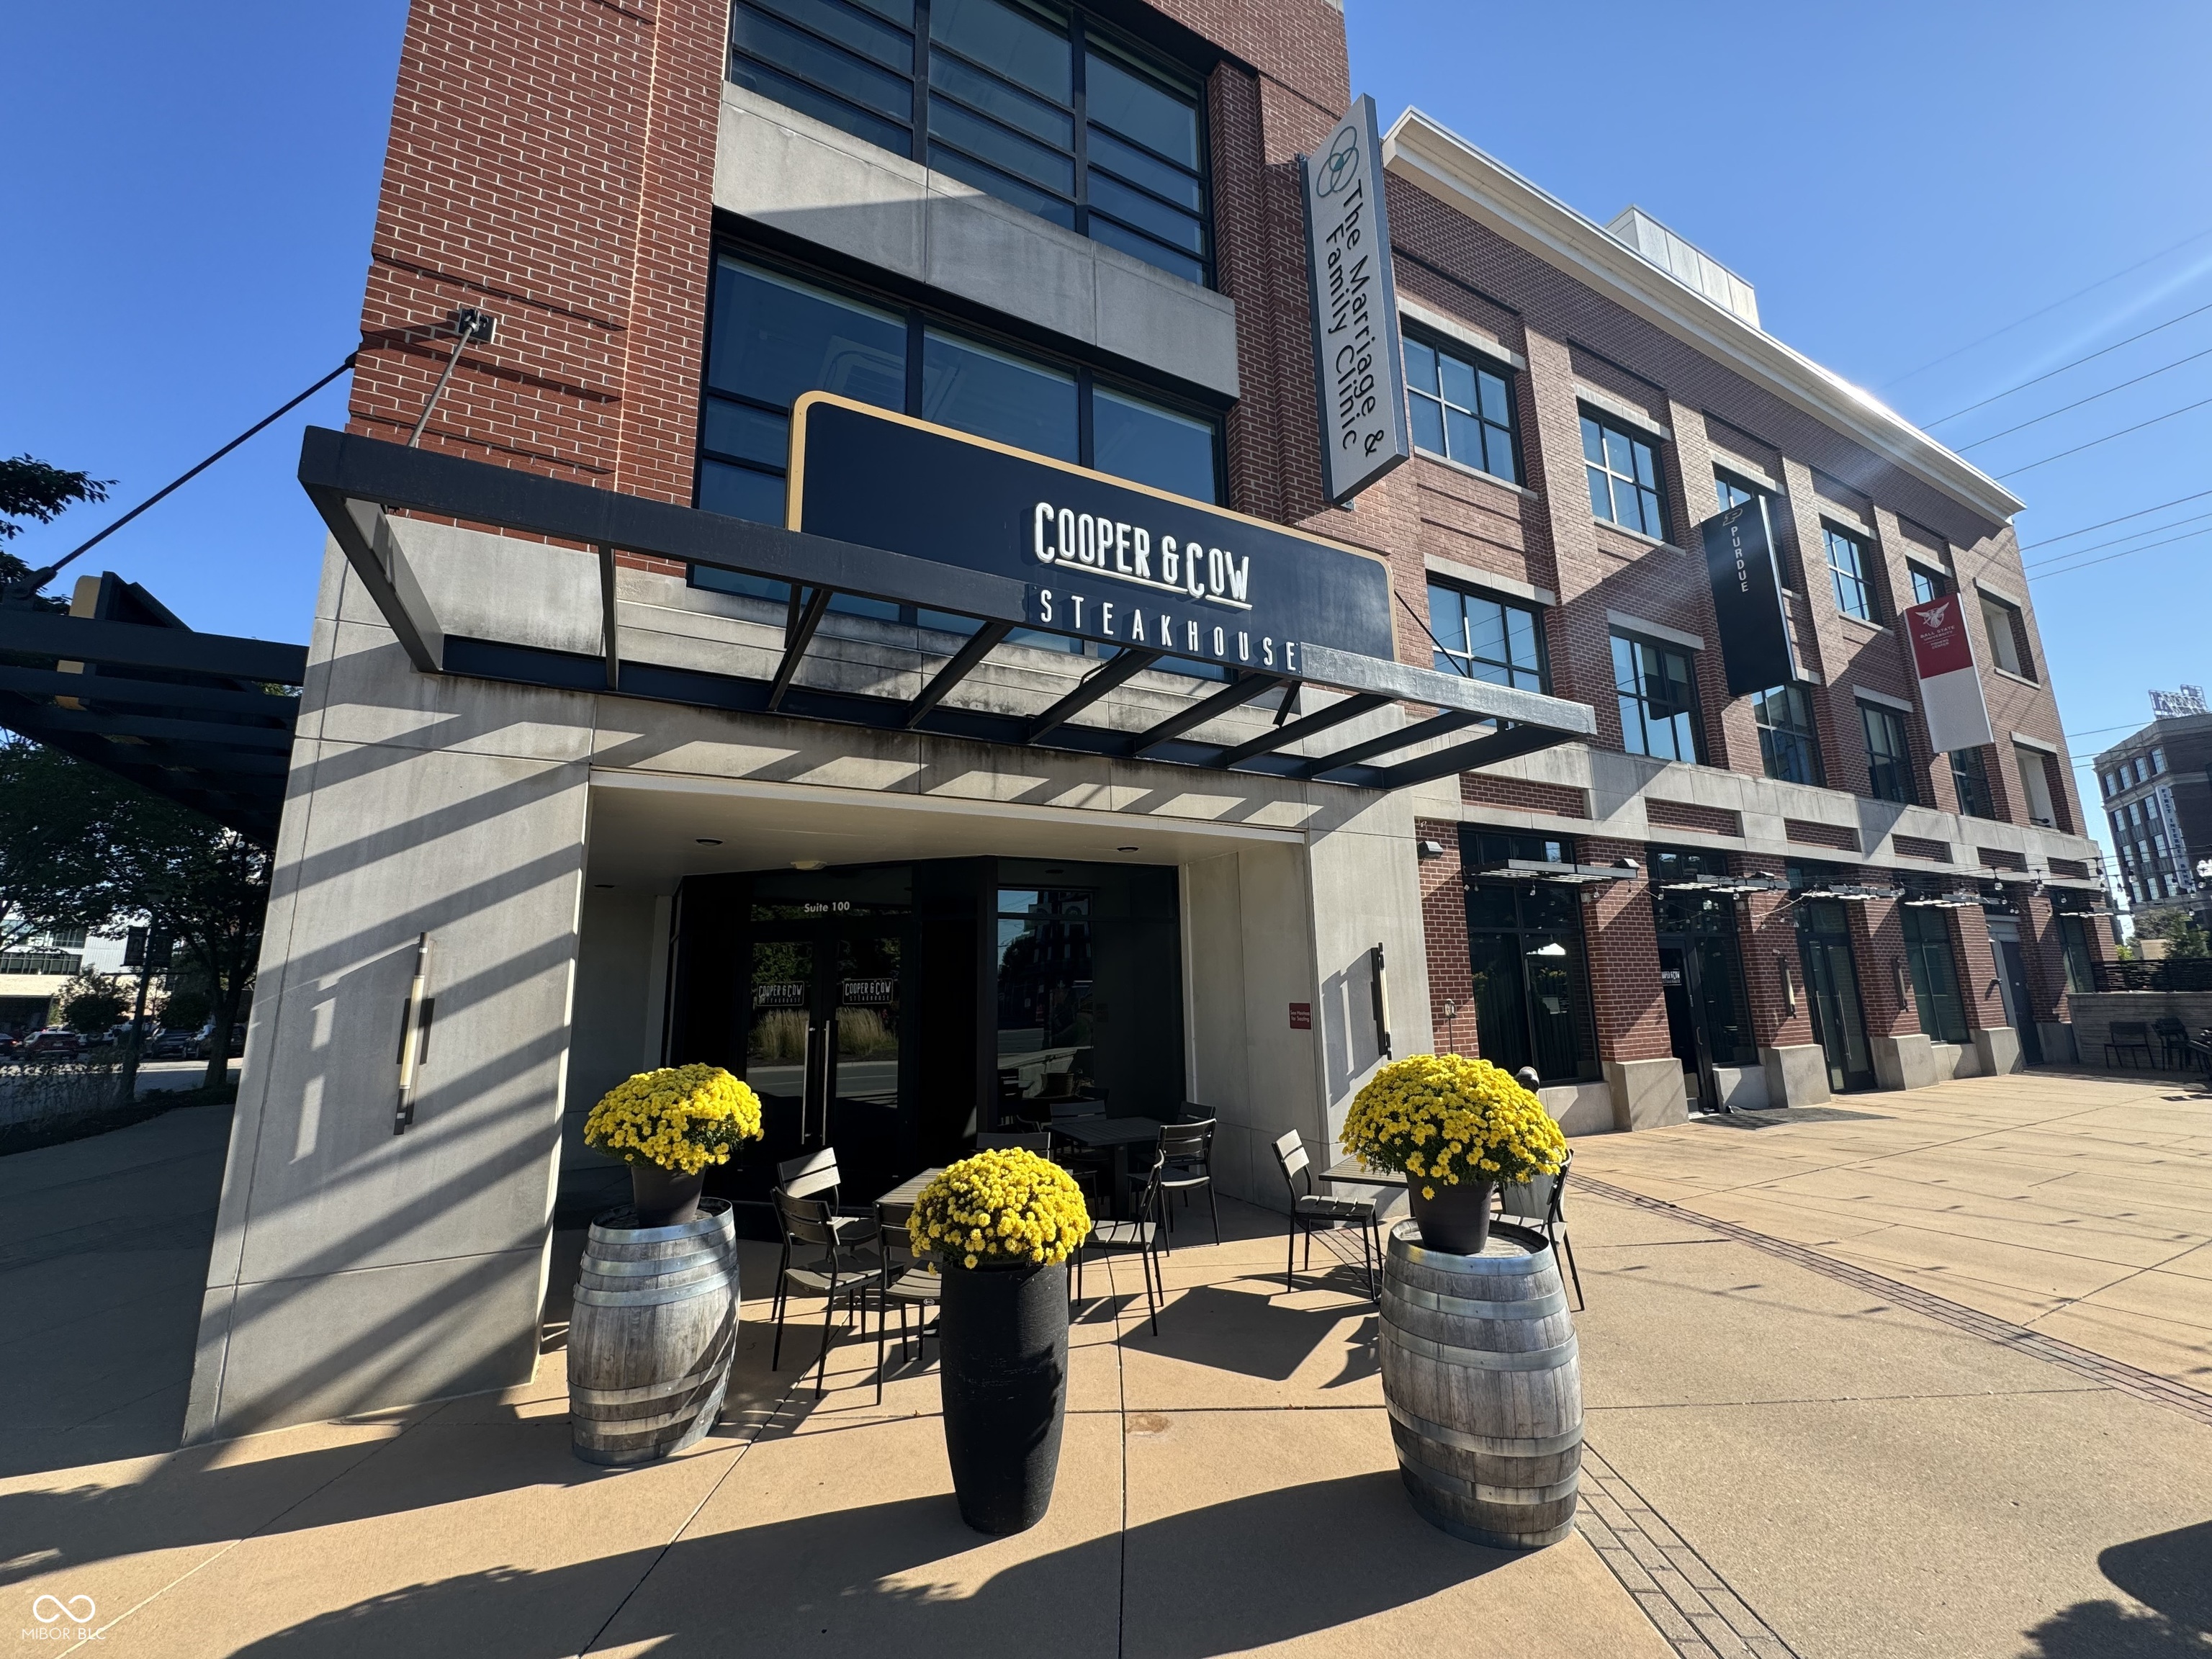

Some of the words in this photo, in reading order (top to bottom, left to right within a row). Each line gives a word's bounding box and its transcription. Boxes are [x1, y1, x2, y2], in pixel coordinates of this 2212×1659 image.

[1343, 179, 1363, 251] The
[1325, 228, 1346, 334] Family
[1348, 253, 1377, 417] Marriage
[1334, 345, 1359, 449] Clinic
[1364, 428, 1385, 458] &
[1034, 502, 1151, 578] COOPER
[1161, 535, 1179, 585] &
[1185, 541, 1250, 603] COW
[1730, 526, 1749, 593] PURDUE
[1040, 589, 1297, 672] STEAKHOUSE
[1923, 630, 1953, 641] UNIVERSITY
[1936, 625, 1956, 634] STATE
[2161, 788, 2172, 814] FIRST
[2170, 818, 2182, 859] INTERNET
[804, 903, 828, 912] Suite
[832, 902, 850, 911] 100
[758, 985, 781, 998] COOPER
[782, 985, 786, 995] &
[787, 984, 802, 997] COW
[845, 982, 868, 996] COOPER
[870, 981, 874, 993] &
[875, 981, 891, 995] COW
